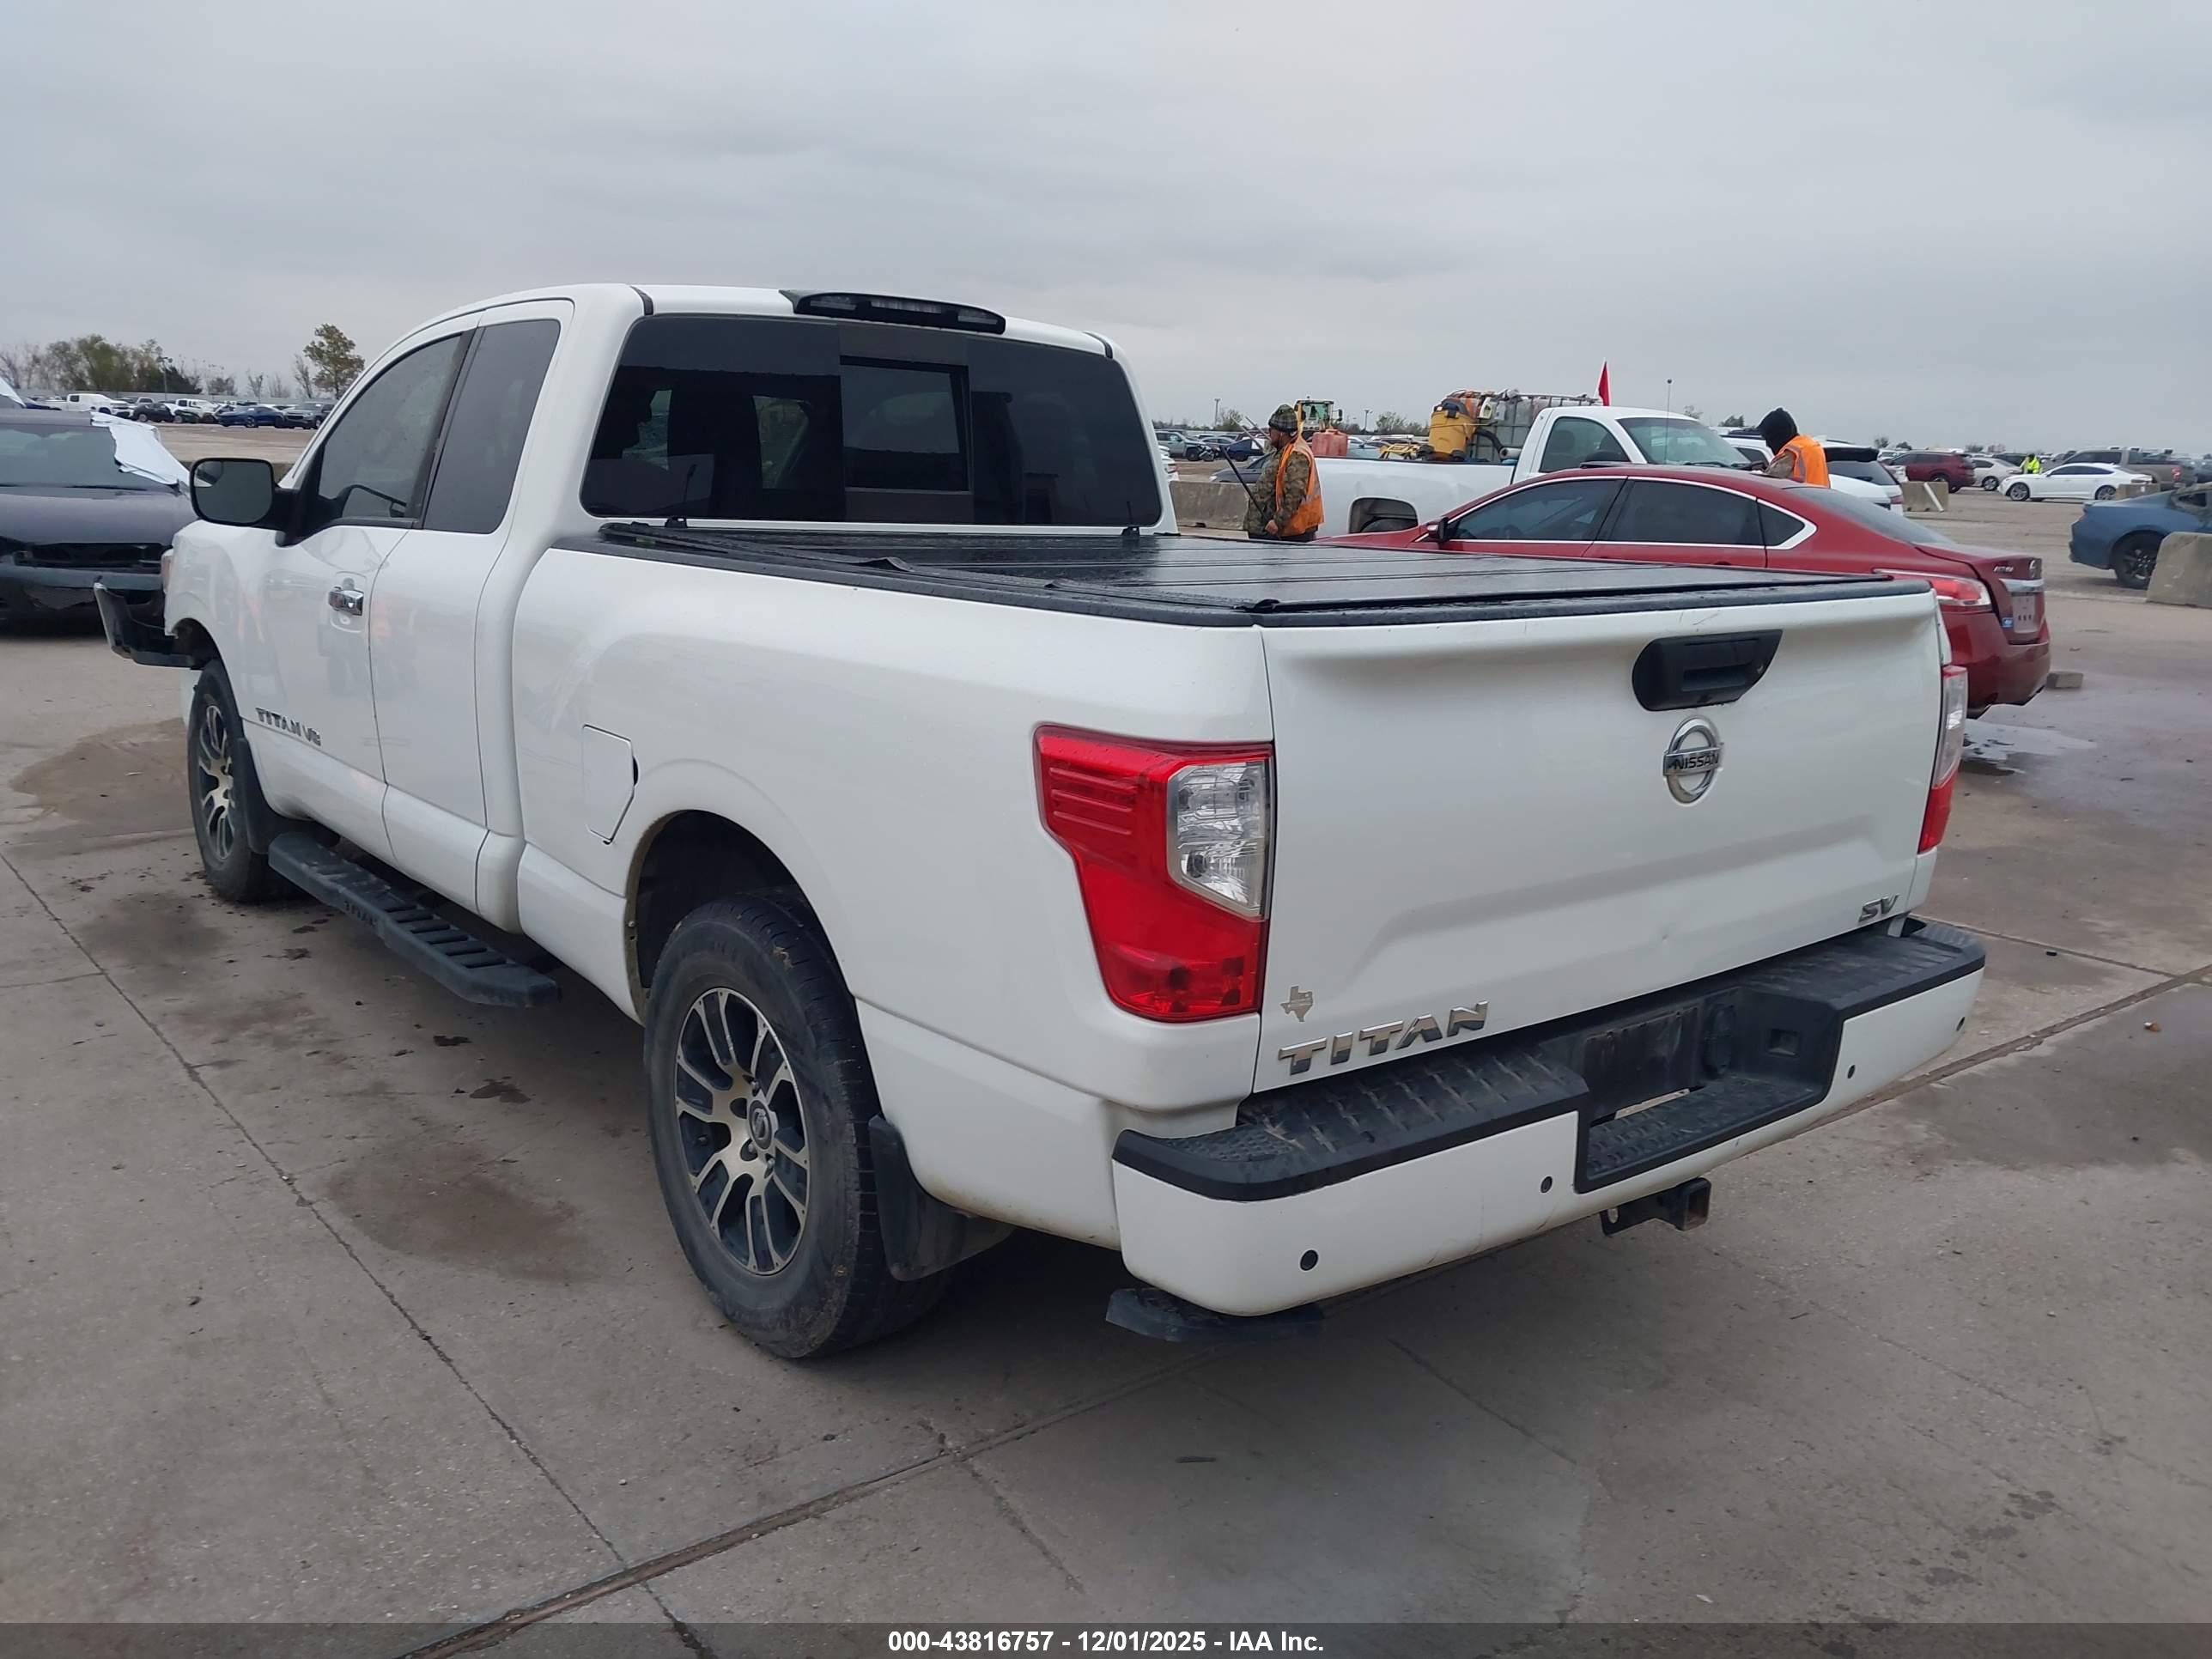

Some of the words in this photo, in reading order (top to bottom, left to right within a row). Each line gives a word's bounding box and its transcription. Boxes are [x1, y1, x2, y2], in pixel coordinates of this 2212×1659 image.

[255, 707, 301, 737] TITAN
[1674, 752, 1719, 770] NISSAN
[1858, 892, 1899, 922] SV
[1277, 1000, 1489, 1076] TITAN
